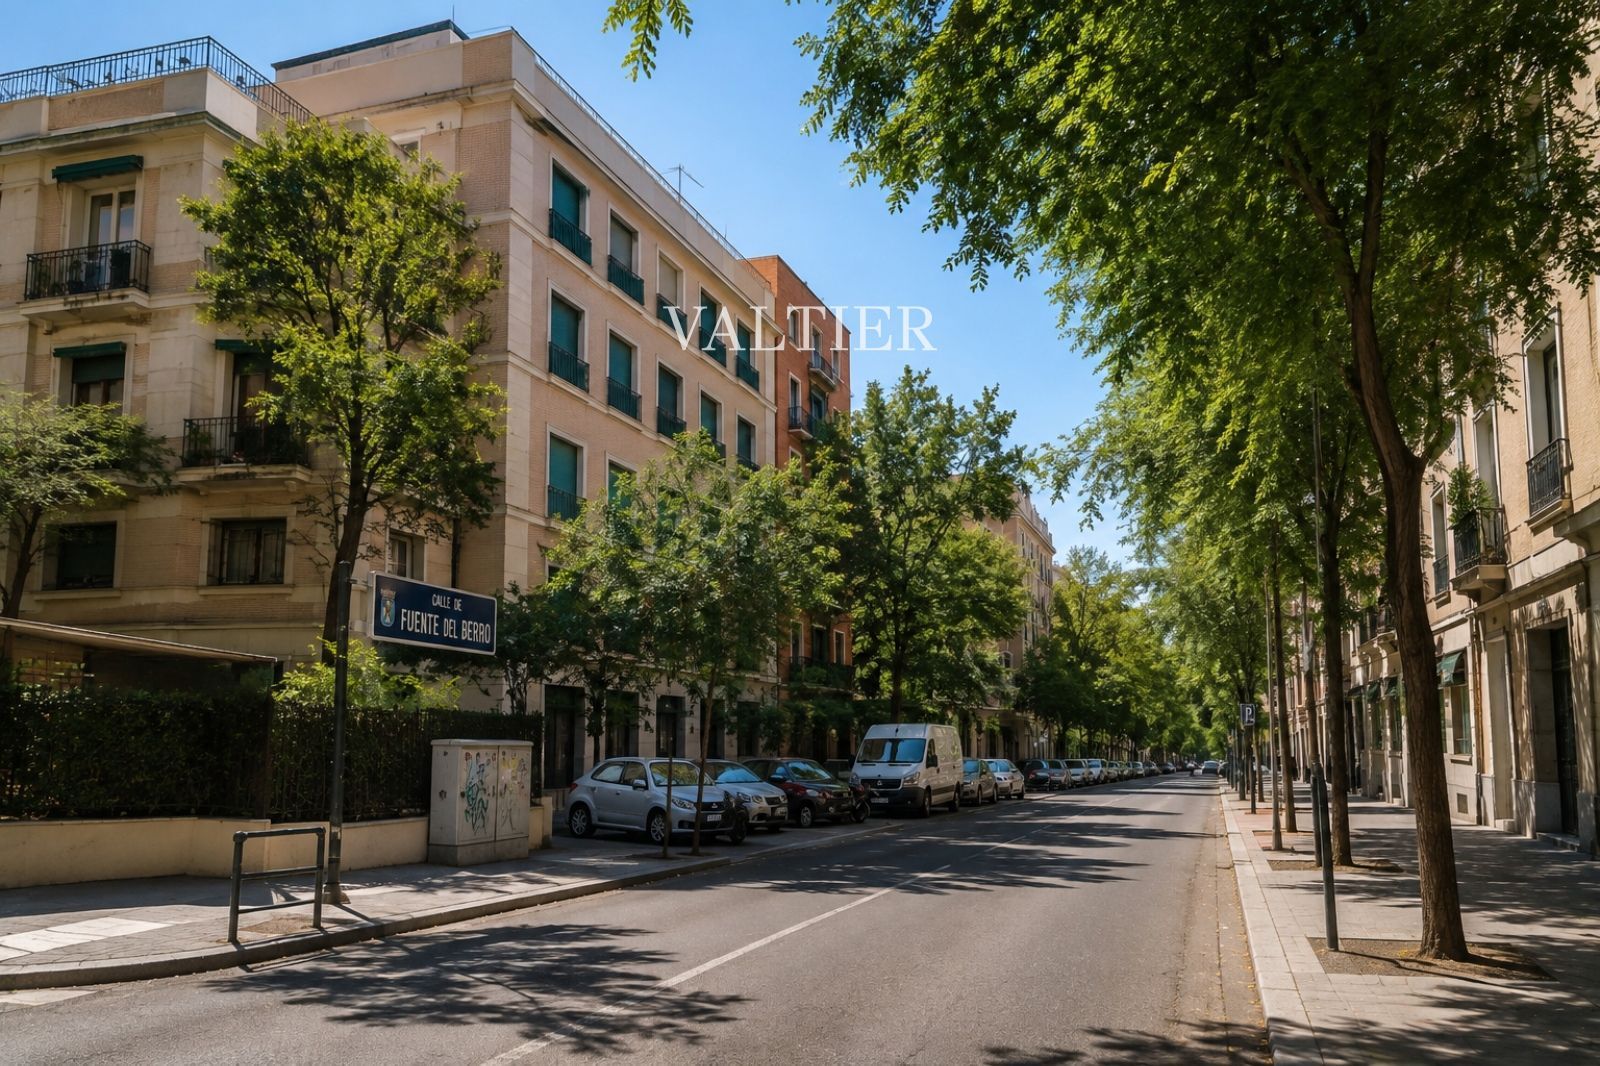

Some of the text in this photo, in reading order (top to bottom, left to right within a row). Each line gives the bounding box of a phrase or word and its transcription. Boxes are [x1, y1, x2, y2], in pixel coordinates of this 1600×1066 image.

[432, 594, 462, 611] CALLE DE
[401, 609, 491, 644] FUENTE DEL BERRO
